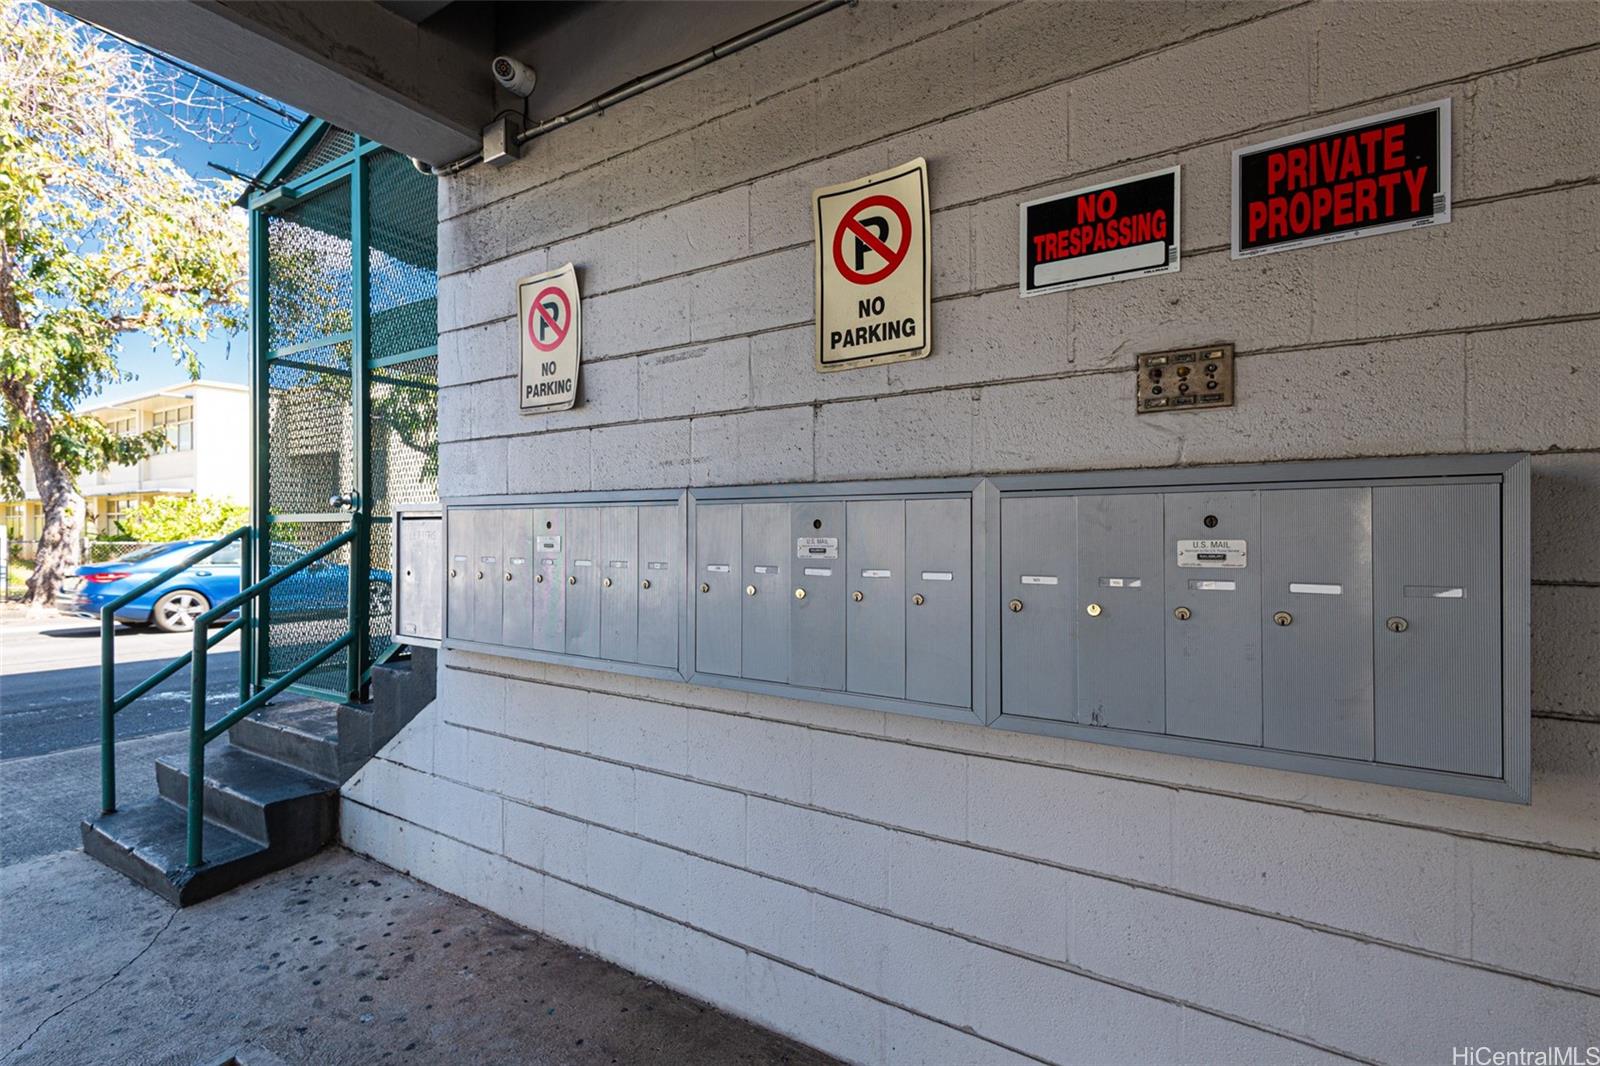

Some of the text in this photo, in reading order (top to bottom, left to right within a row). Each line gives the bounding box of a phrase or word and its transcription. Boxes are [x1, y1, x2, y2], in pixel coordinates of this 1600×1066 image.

[1267, 124, 1406, 195] PRIVATE
[1077, 190, 1118, 225] NO
[1248, 166, 1429, 242] PROPERTY
[1033, 209, 1167, 262] TRESPASSING
[858, 296, 886, 318] NO
[830, 317, 916, 350] PARKING
[541, 361, 557, 376] NO
[526, 378, 572, 399] PARKING
[1192, 541, 1231, 549] U.S. MAIL
